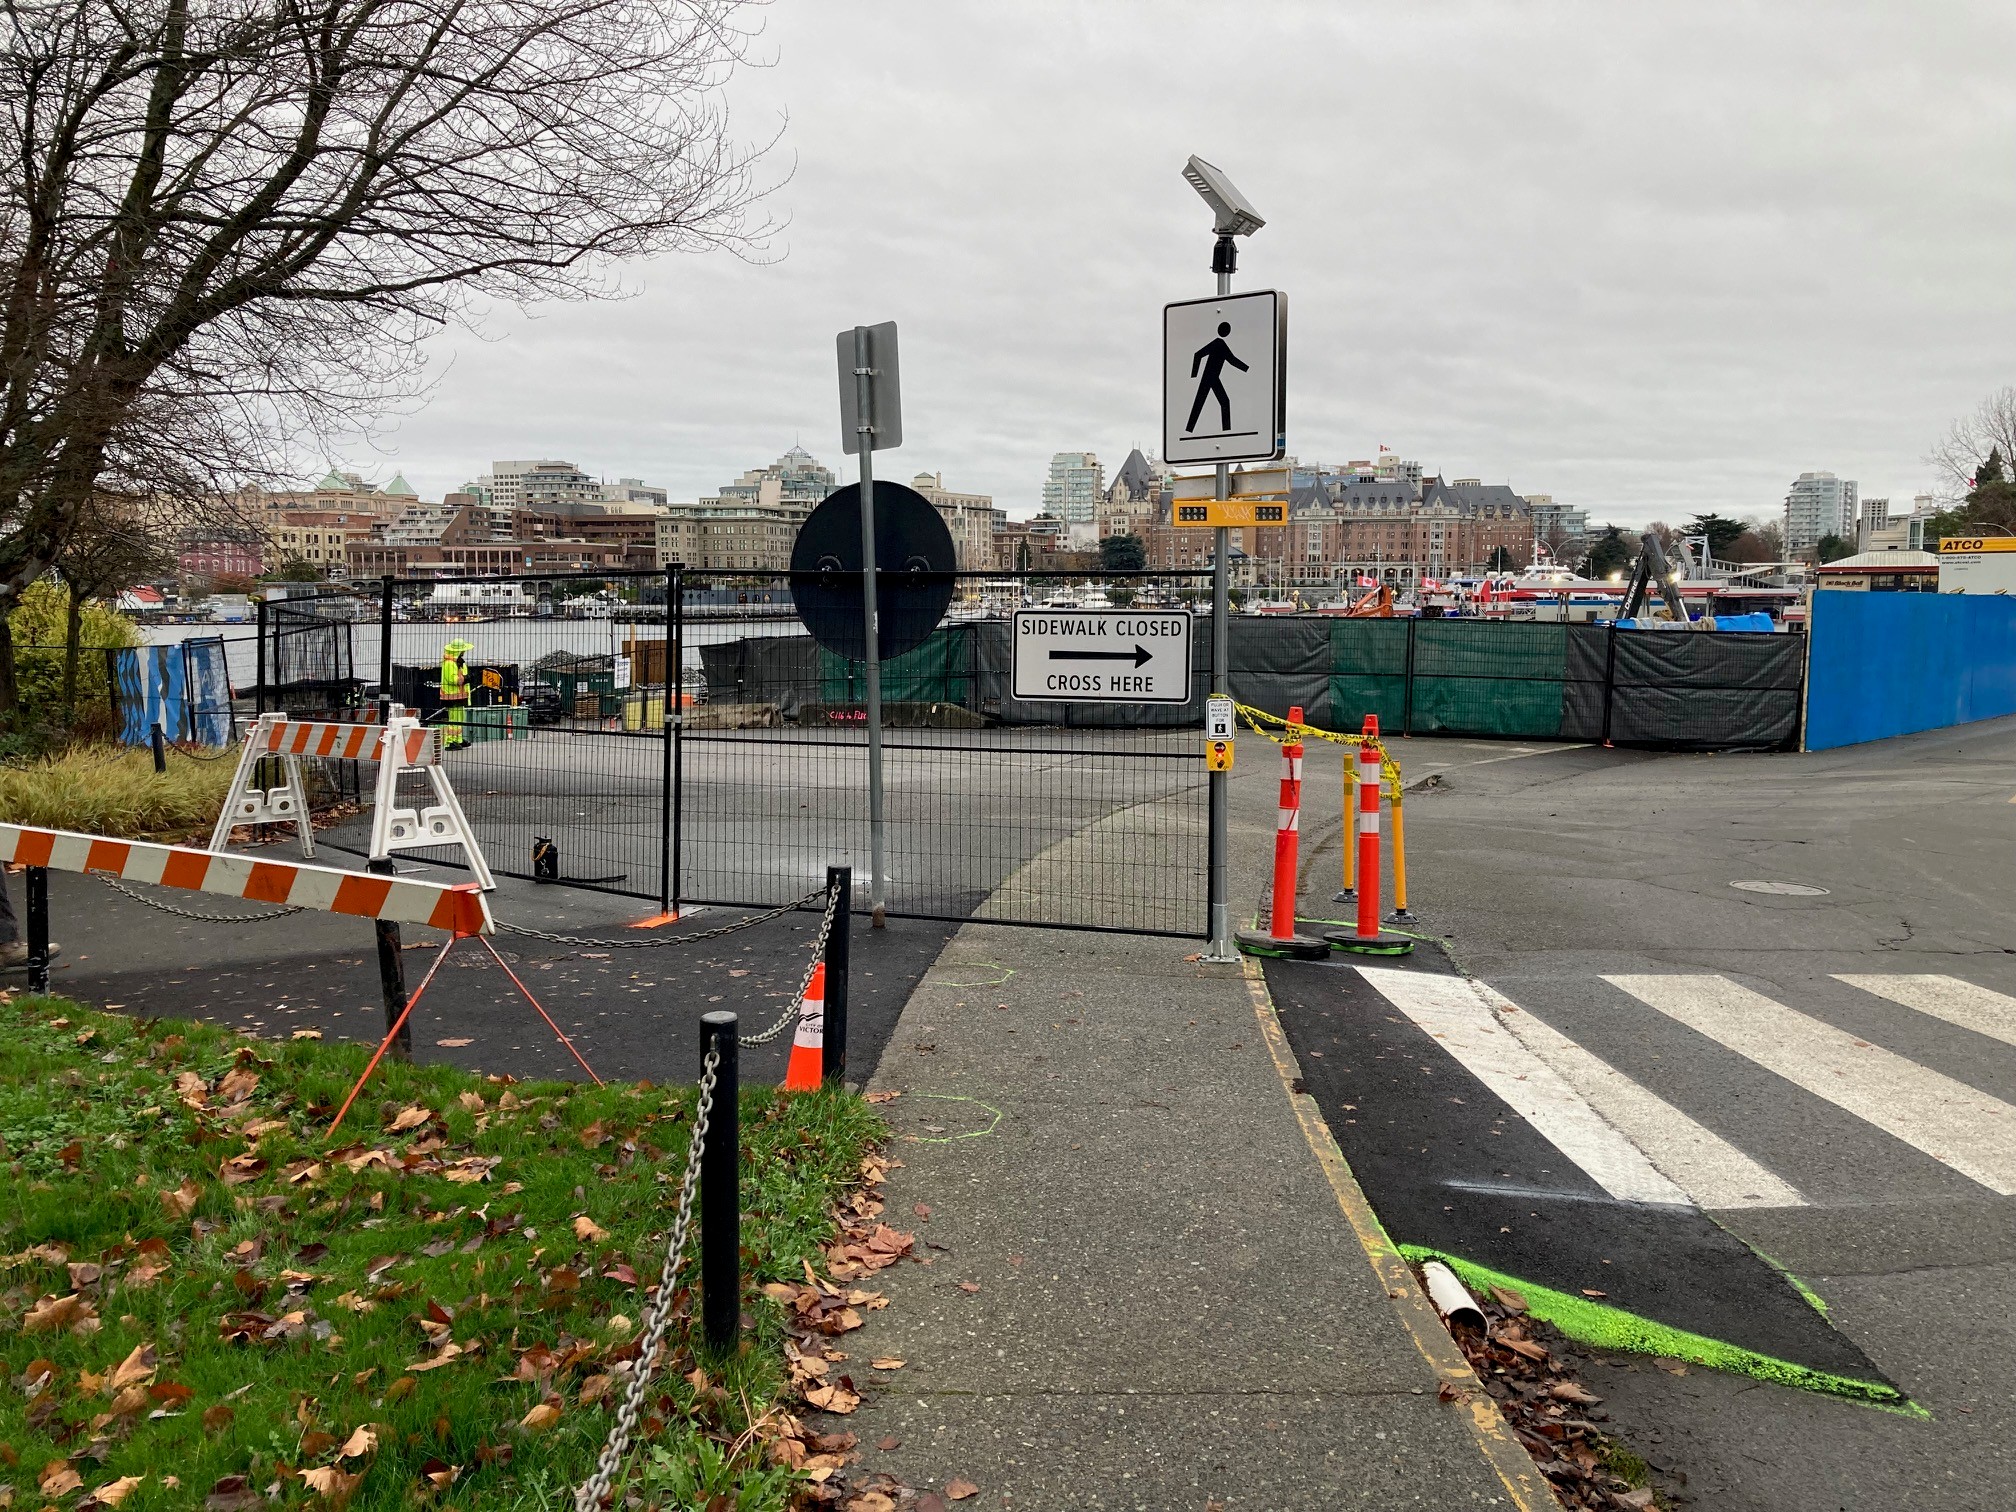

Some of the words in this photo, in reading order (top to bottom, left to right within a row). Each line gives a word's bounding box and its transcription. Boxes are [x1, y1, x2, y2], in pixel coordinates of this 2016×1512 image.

[1943, 540, 1983, 550] ATCO
[1624, 580, 1639, 610] DEERE
[1021, 619, 1107, 636] SIDEWALK
[1116, 620, 1182, 637] CLOSED
[1047, 674, 1101, 691] CROSS
[1110, 676, 1154, 692] HERE
